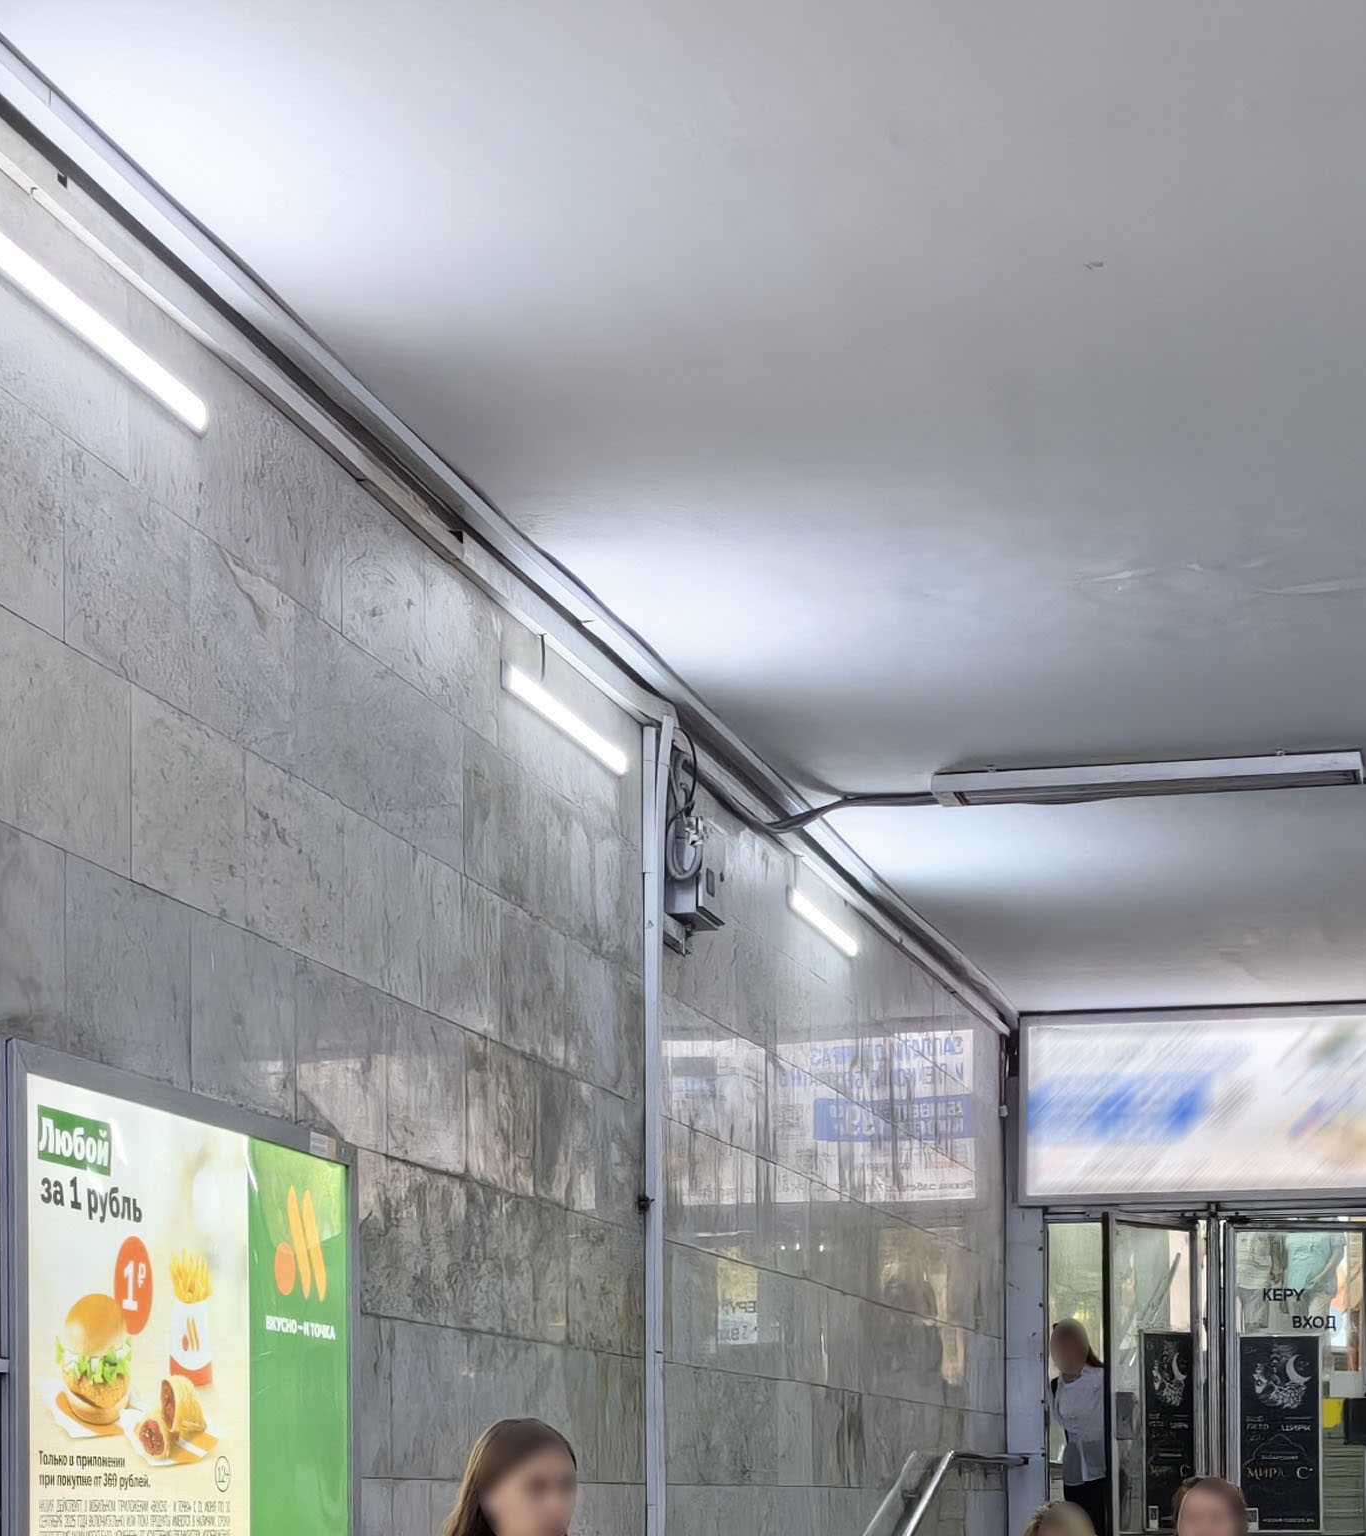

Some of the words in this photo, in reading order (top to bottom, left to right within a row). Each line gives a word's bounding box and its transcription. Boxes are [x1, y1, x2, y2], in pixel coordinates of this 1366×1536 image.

[39, 1116, 110, 1167] Любой
[40, 1177, 65, 1207] за
[70, 1177, 83, 1210] 1
[87, 1186, 143, 1225] рубль
[1292, 1315, 1337, 1331] ВХОД
[39, 1450, 67, 1467] Только
[39, 1474, 55, 1489] при
